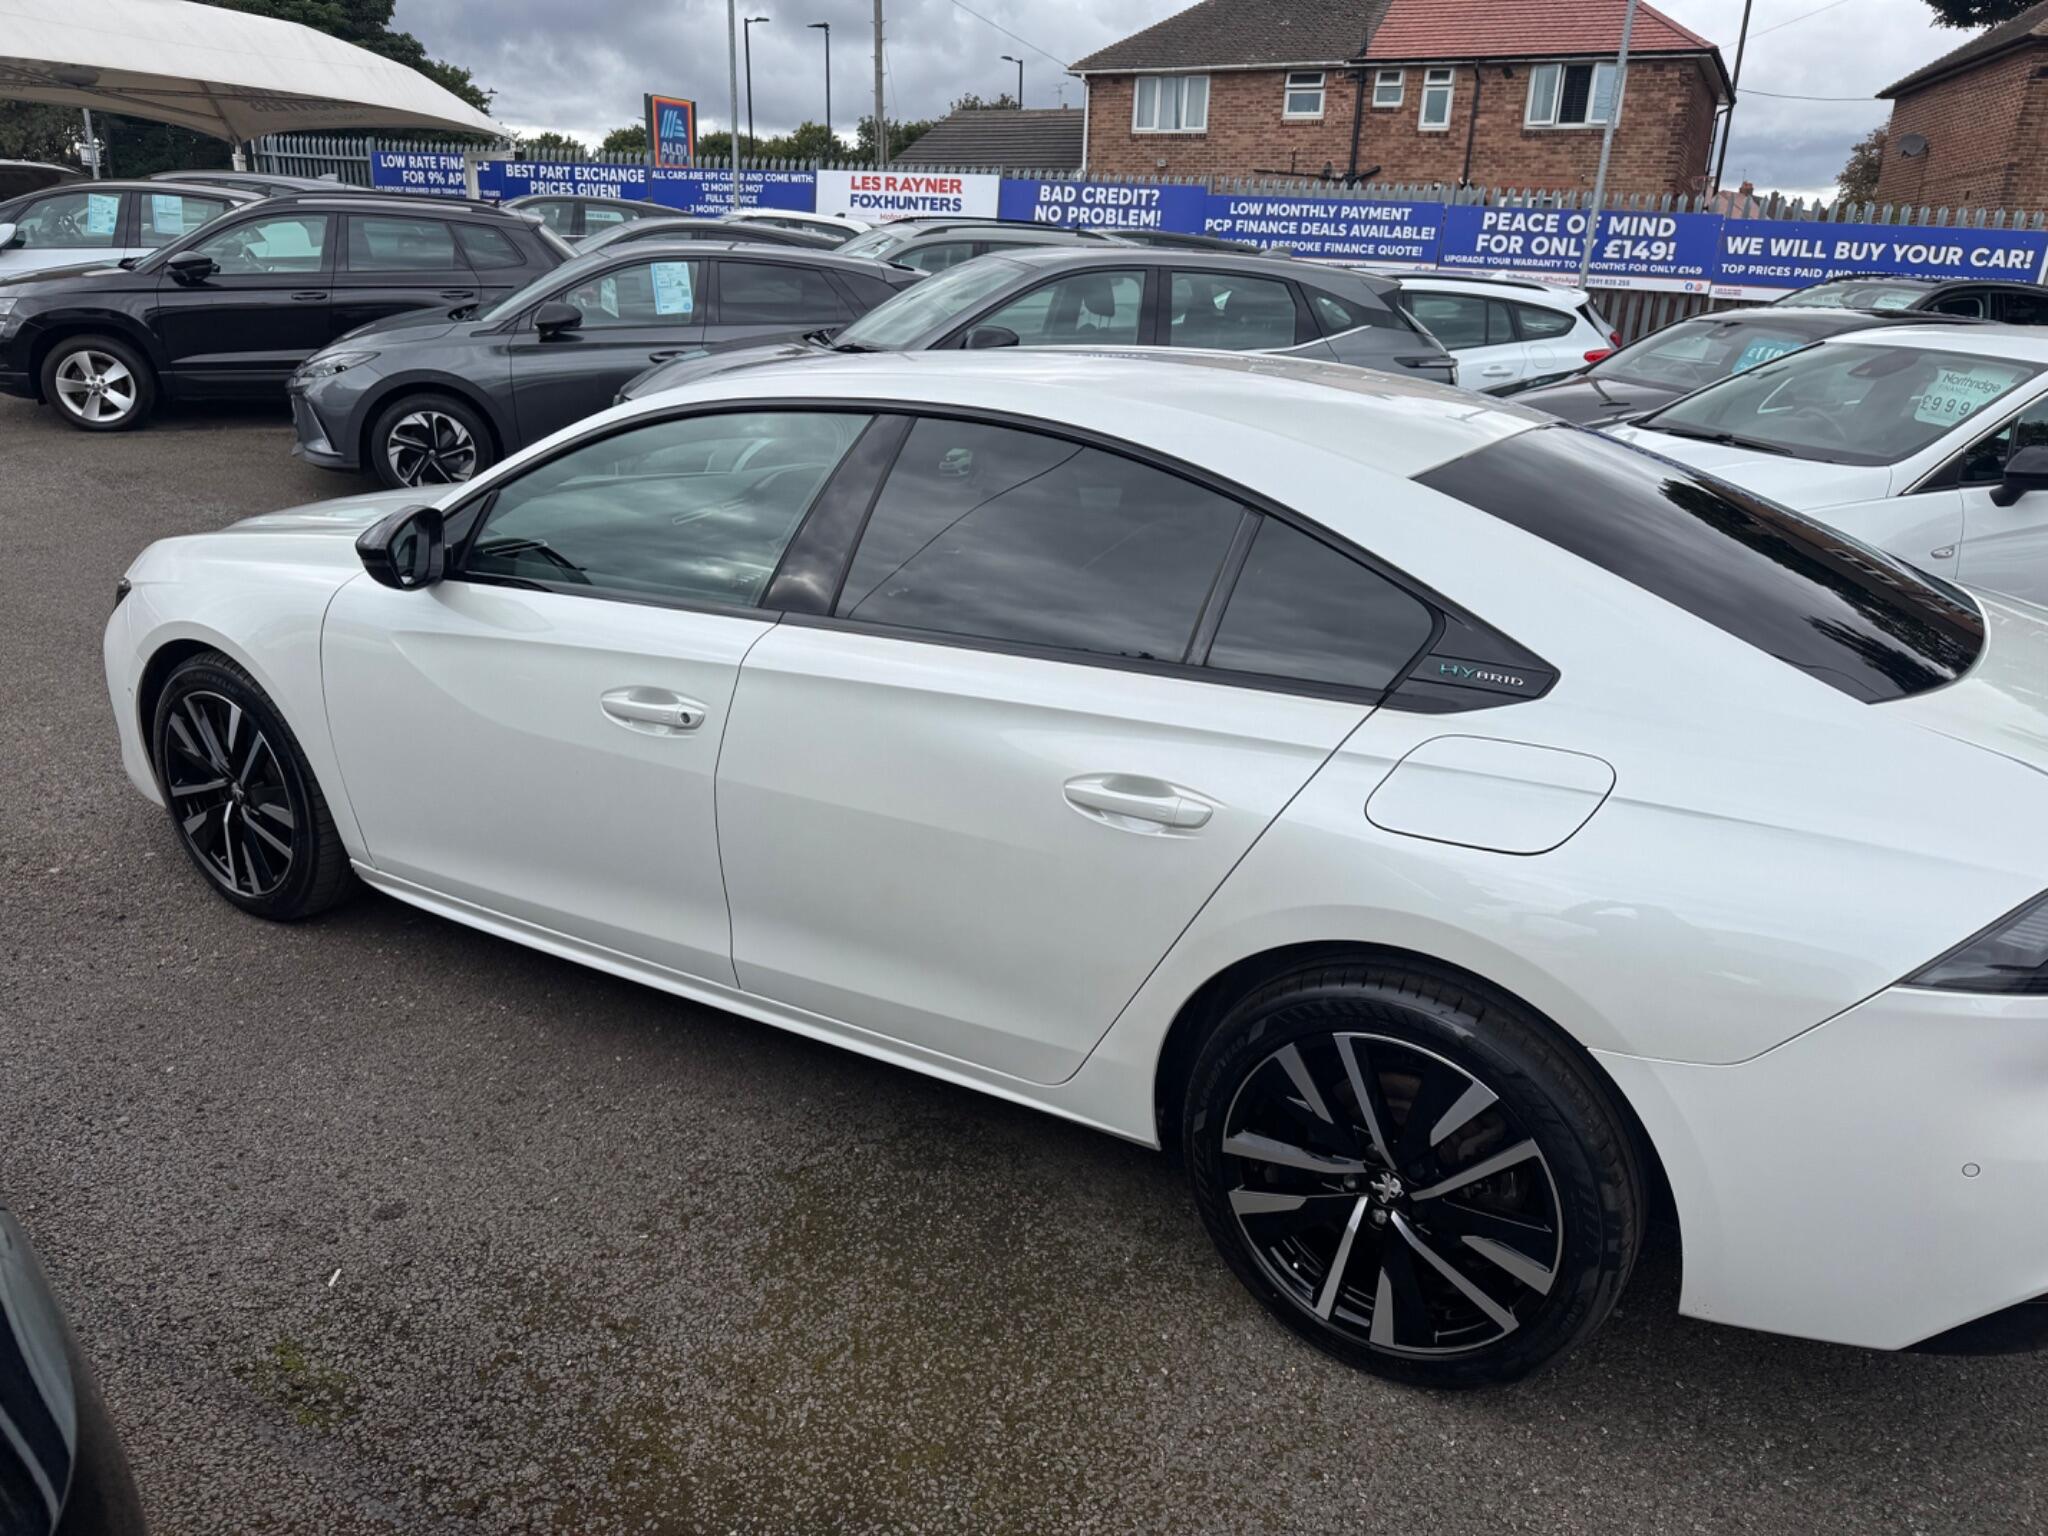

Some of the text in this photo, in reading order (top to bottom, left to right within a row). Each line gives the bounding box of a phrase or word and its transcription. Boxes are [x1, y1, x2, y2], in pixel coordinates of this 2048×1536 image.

[661, 141, 687, 156] ALDI
[380, 154, 490, 171] LOW RATE FINACE
[402, 170, 425, 184] FOR
[428, 171, 445, 185] 9%
[506, 164, 645, 183] BEST PART EXCHANGE
[652, 170, 815, 183] ALL CARS ARE HPI CLER AND COME WITH:
[530, 181, 621, 198] PRICES GIVEN!
[701, 184, 763, 193] 12 MONTS MOT
[851, 176, 963, 194] LES RAYNER
[705, 195, 758, 204] FULL SEVICE
[850, 194, 962, 212] FOXHUNTERS
[1039, 185, 1160, 206] BAD CREDIT?
[1034, 205, 1162, 227] NO PROBLEM!
[1230, 201, 1412, 221] LOW MONTHLY PAYMENT
[1204, 218, 1436, 240] PCP FINANCE DEALS AVAILABLE!
[1482, 211, 1560, 233] PEACE
[1608, 216, 1676, 237] MIND
[1260, 239, 1268, 249] A
[1270, 240, 1321, 252] BESPOKE
[1324, 243, 1375, 255] FINANCE
[1377, 245, 1423, 256] QUOTE!
[1475, 233, 1524, 254] FOR
[1602, 239, 1677, 261] £149!
[1727, 236, 2035, 270] WE WILL BUY YOUR CAR!
[1444, 254, 1485, 264] UPGRADE
[1486, 256, 1512, 265] YOUR
[1512, 257, 1561, 268] WARRANTY
[1563, 260, 1577, 269] TO
[1628, 263, 1648, 272] FOR
[1649, 264, 1677, 274] ONLY
[1677, 265, 1703, 275] £149
[1721, 263, 1746, 274] TOP
[1748, 265, 1791, 277] PRICES
[1793, 267, 1823, 278] PAID
[1943, 373, 2001, 394] Northridge
[1440, 663, 1524, 687] HYBRID
